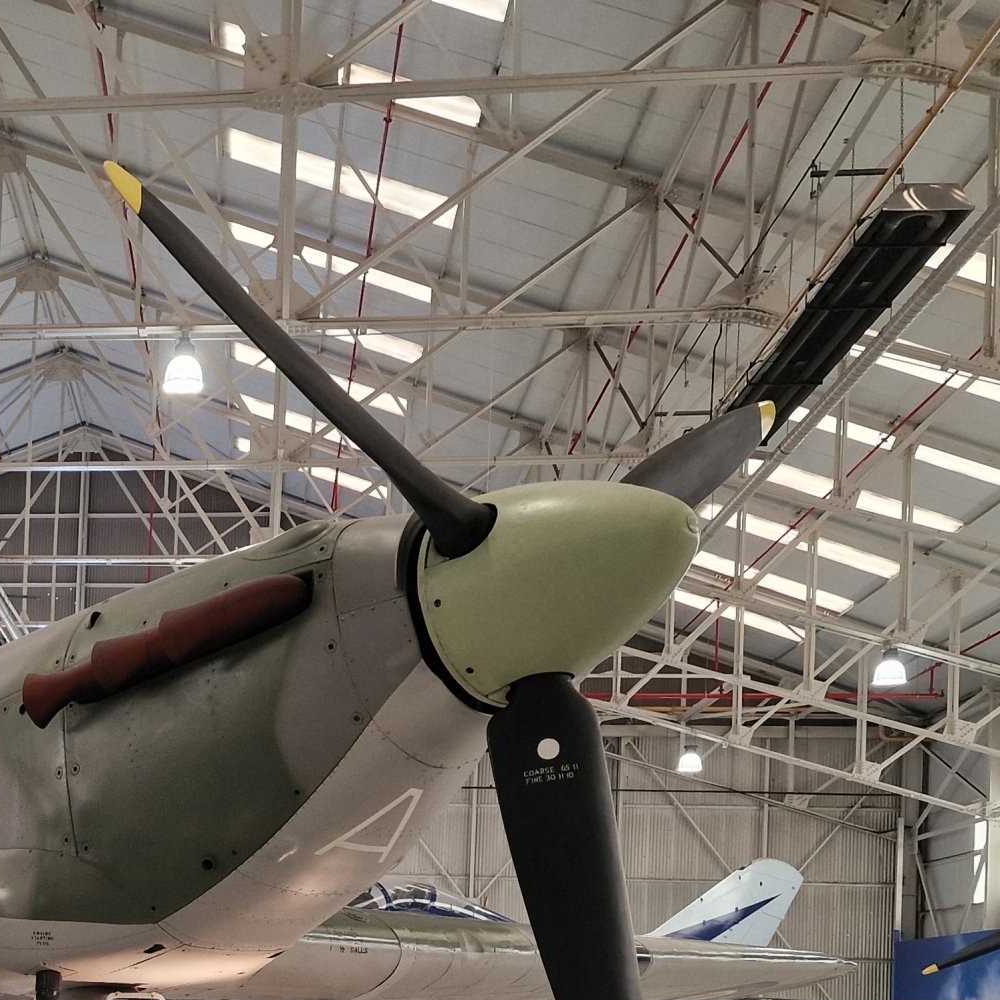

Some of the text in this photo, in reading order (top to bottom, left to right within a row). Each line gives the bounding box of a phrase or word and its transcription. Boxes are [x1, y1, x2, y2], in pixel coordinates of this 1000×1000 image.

[523, 767, 555, 777] COARSE
[525, 776, 543, 785] FINE
[314, 787, 424, 863] A
